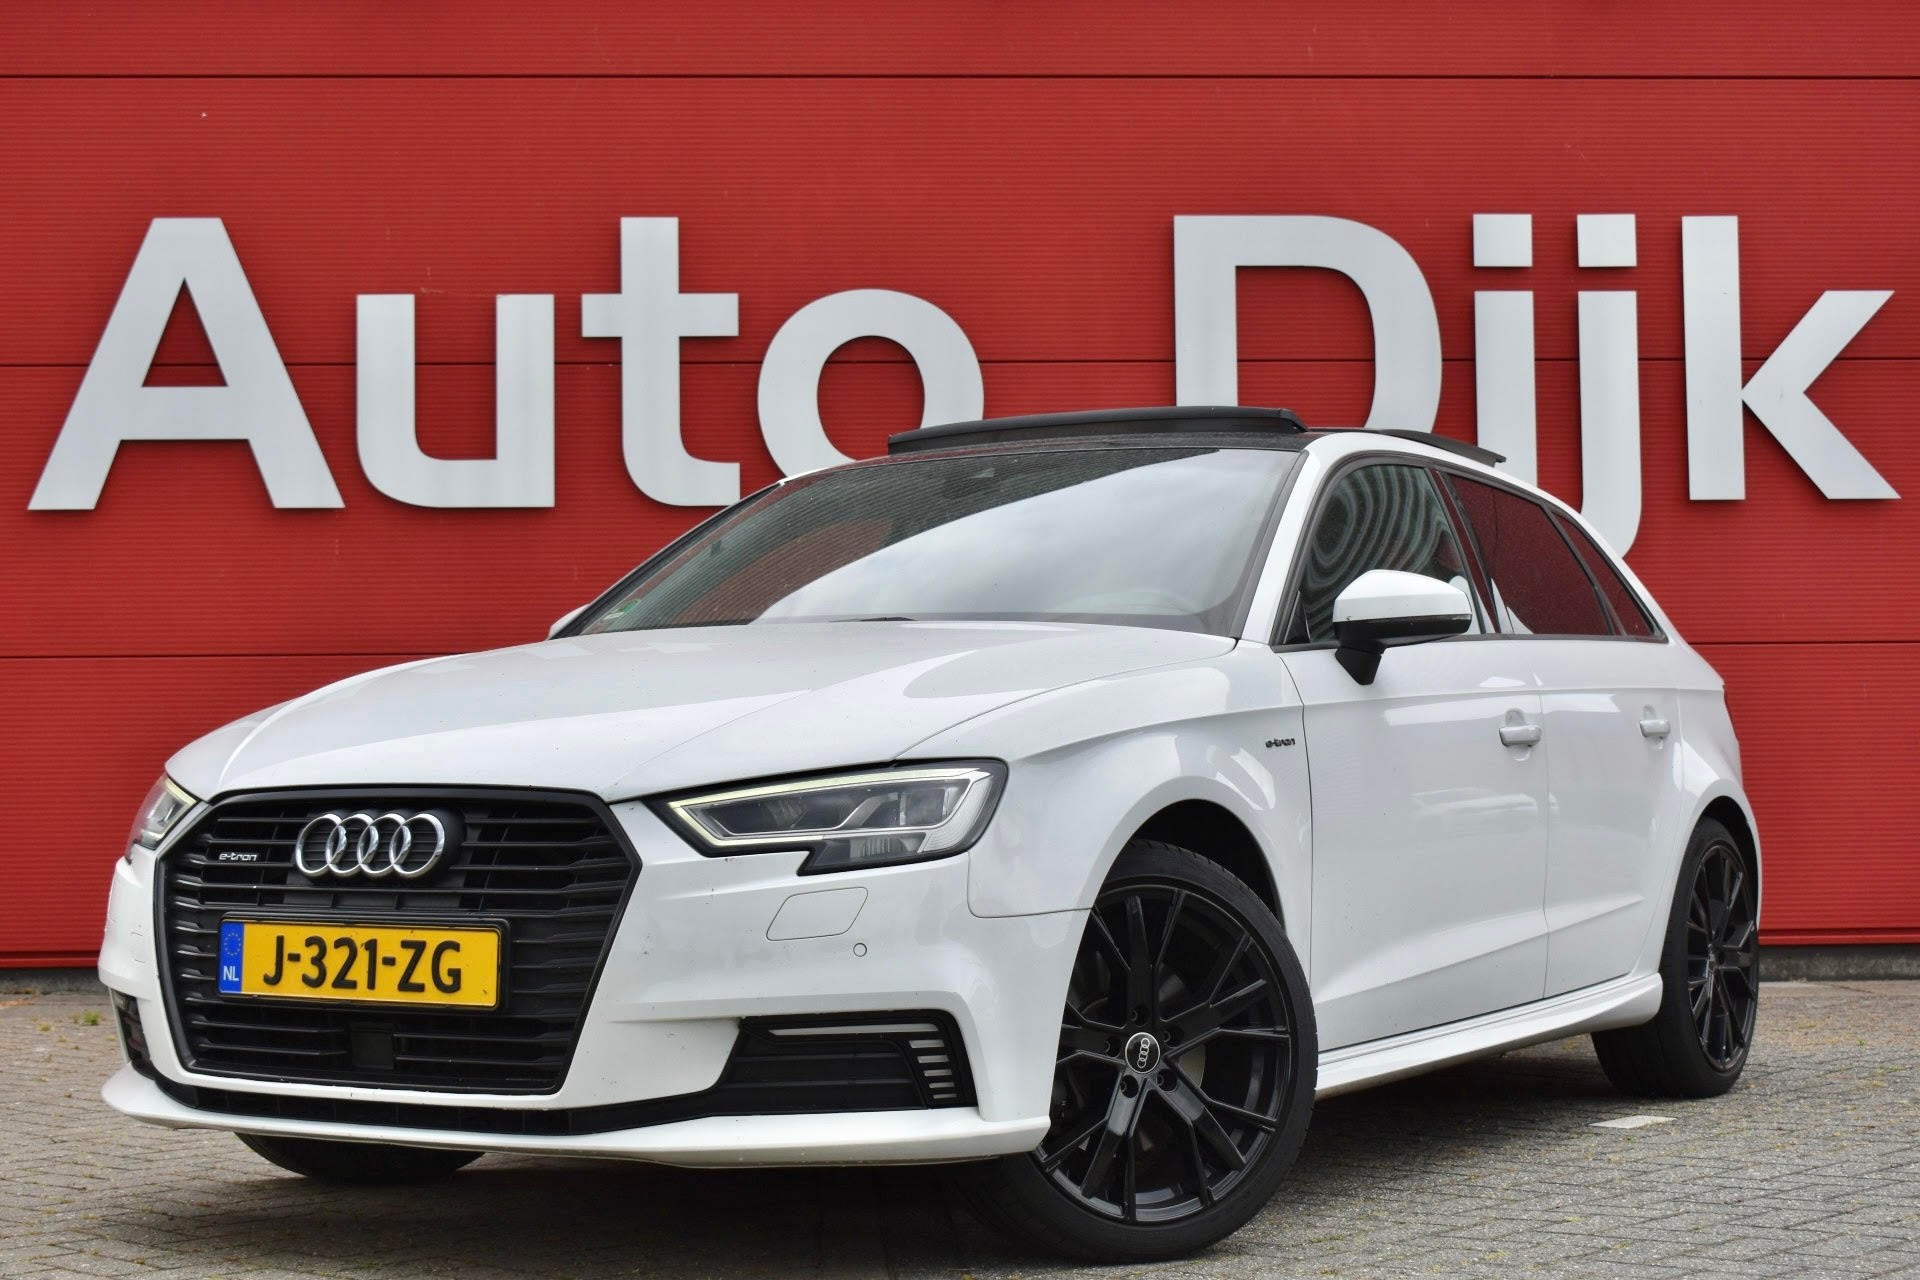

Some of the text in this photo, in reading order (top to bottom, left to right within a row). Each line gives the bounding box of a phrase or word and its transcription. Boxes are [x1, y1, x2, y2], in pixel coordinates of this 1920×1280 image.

[28, 214, 1901, 559] Auto Dijk
[219, 852, 257, 861] e-tron
[222, 965, 240, 982] NL
[263, 935, 462, 994] J-321-ZG
